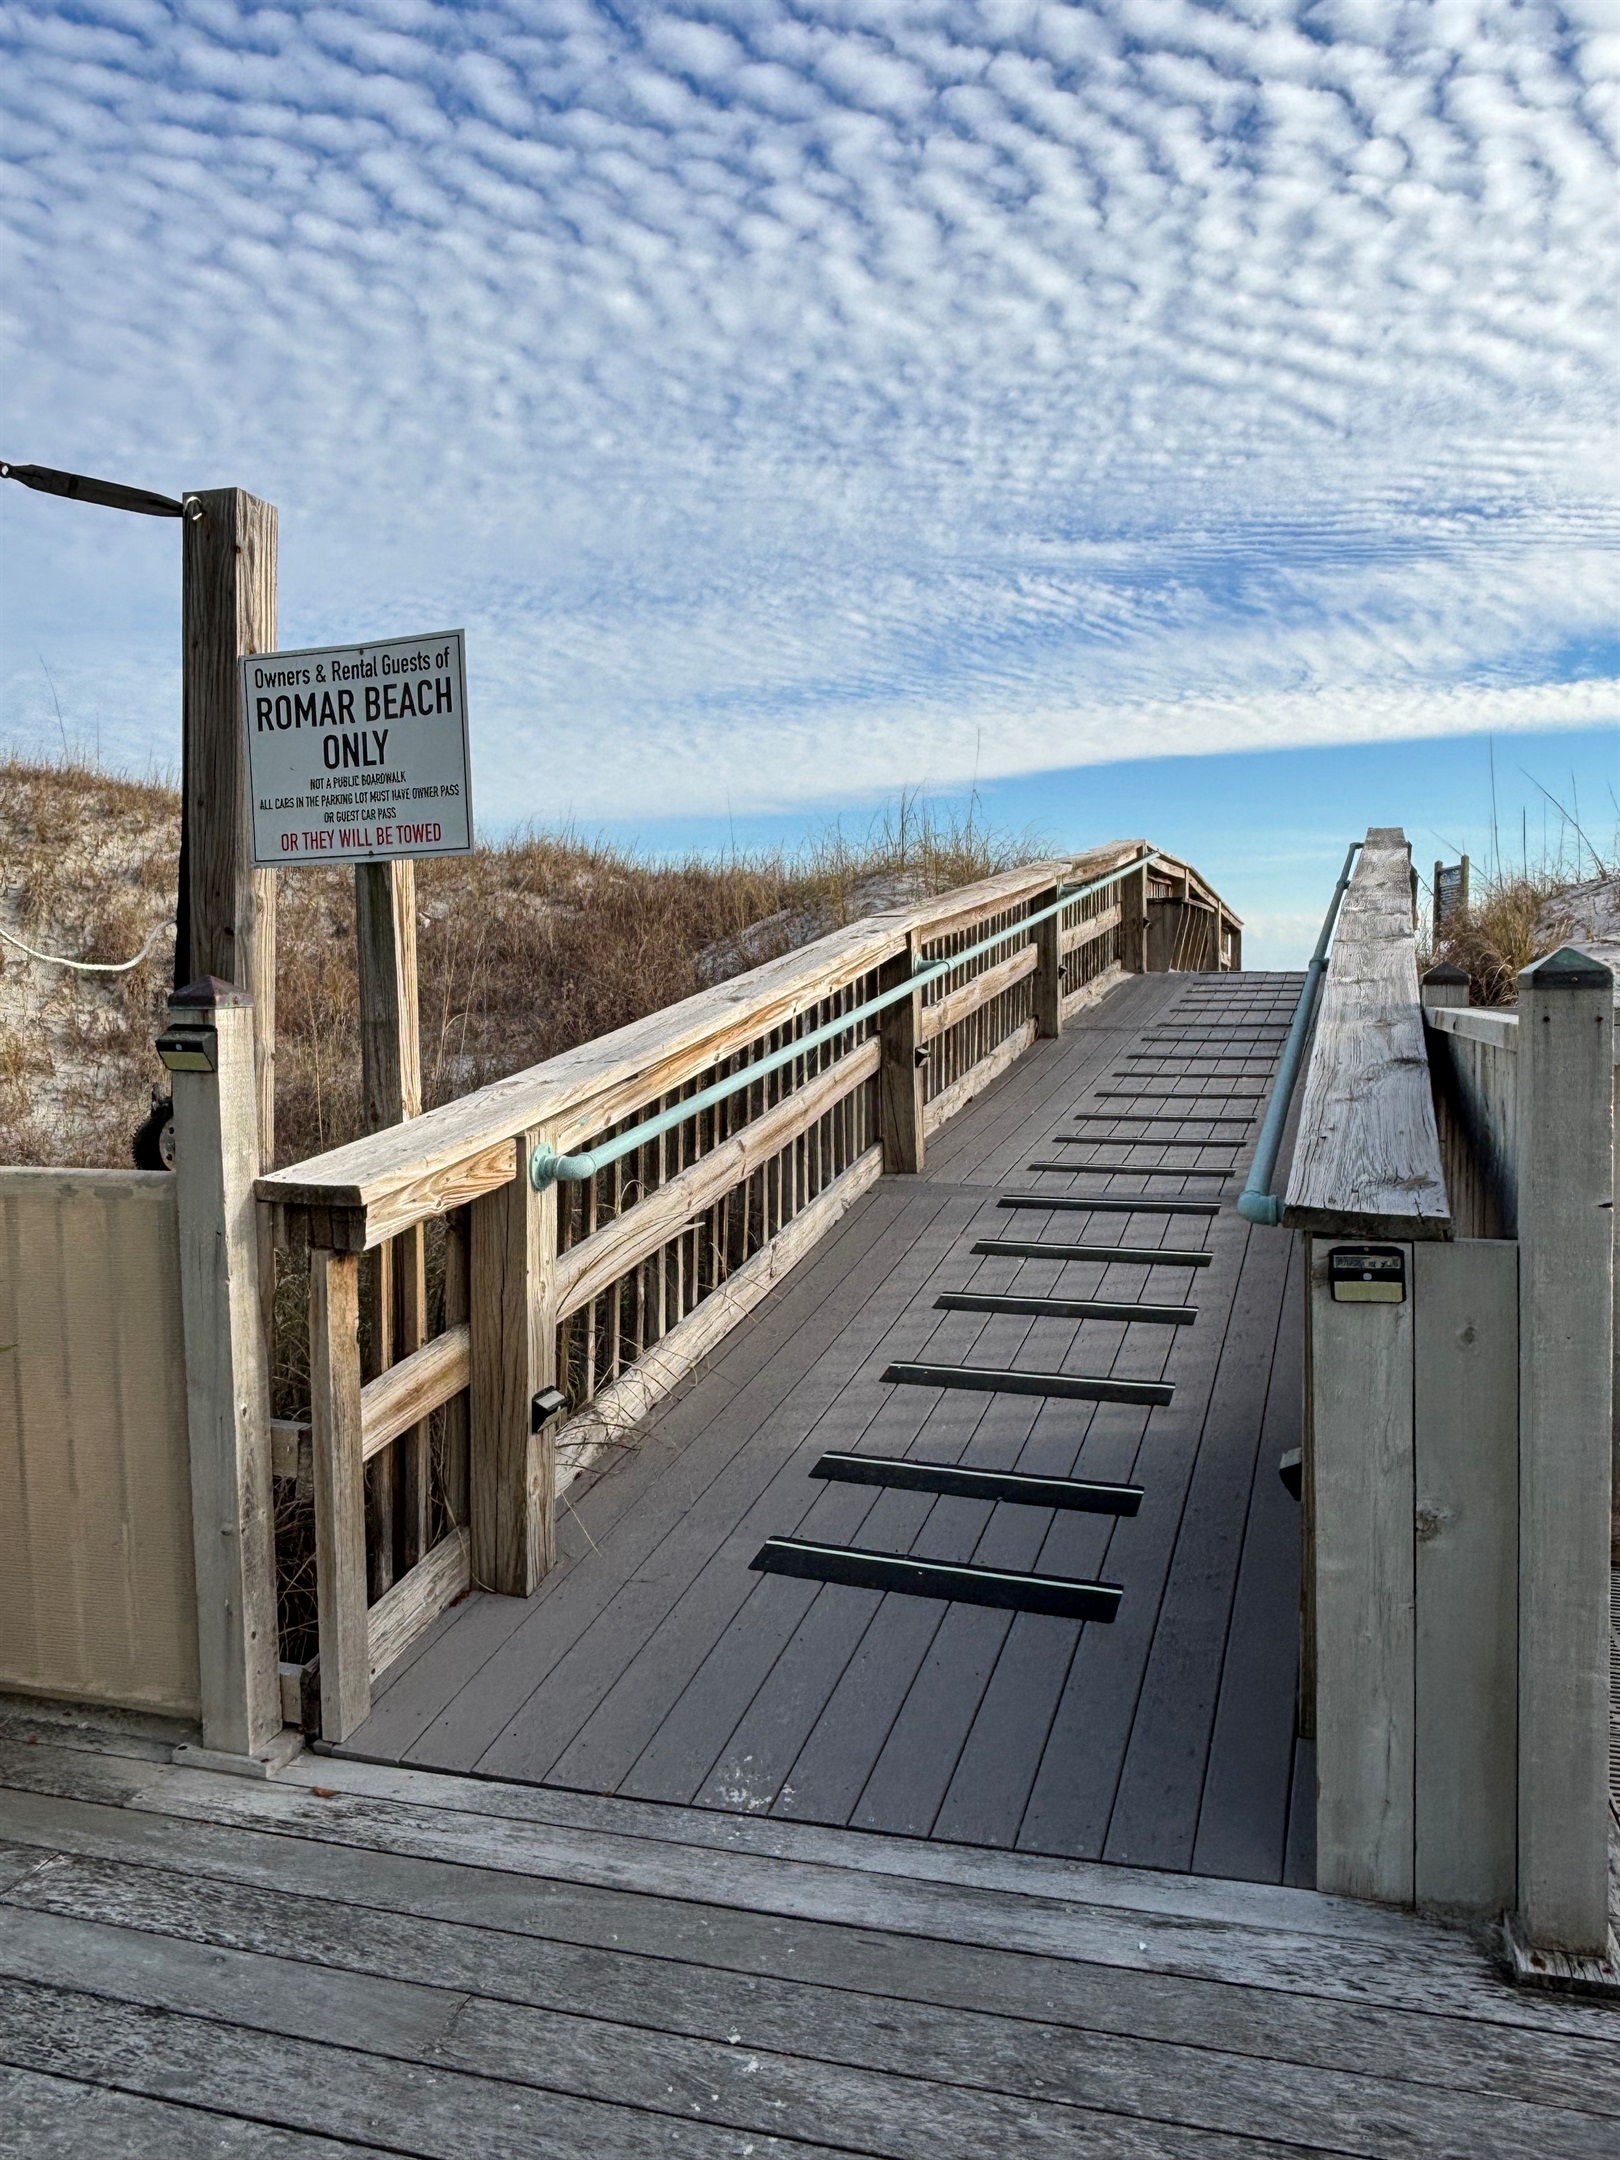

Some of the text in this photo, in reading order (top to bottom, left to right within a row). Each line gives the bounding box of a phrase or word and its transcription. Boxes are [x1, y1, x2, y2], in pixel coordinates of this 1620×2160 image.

[254, 646, 450, 689] Owners & Rental Guests of
[256, 676, 452, 732] ROMAR BEACH
[323, 729, 389, 769] ONLY
[310, 771, 406, 790] NOT A PUBLIC BOARDWALK
[260, 784, 460, 810] ALL CARS IN THE PARKING LOT MUST HAVE OWNER PASS
[324, 806, 397, 823] OR GUEST CAR PASS
[281, 823, 442, 851] OR THEY WILL BE TOWED
